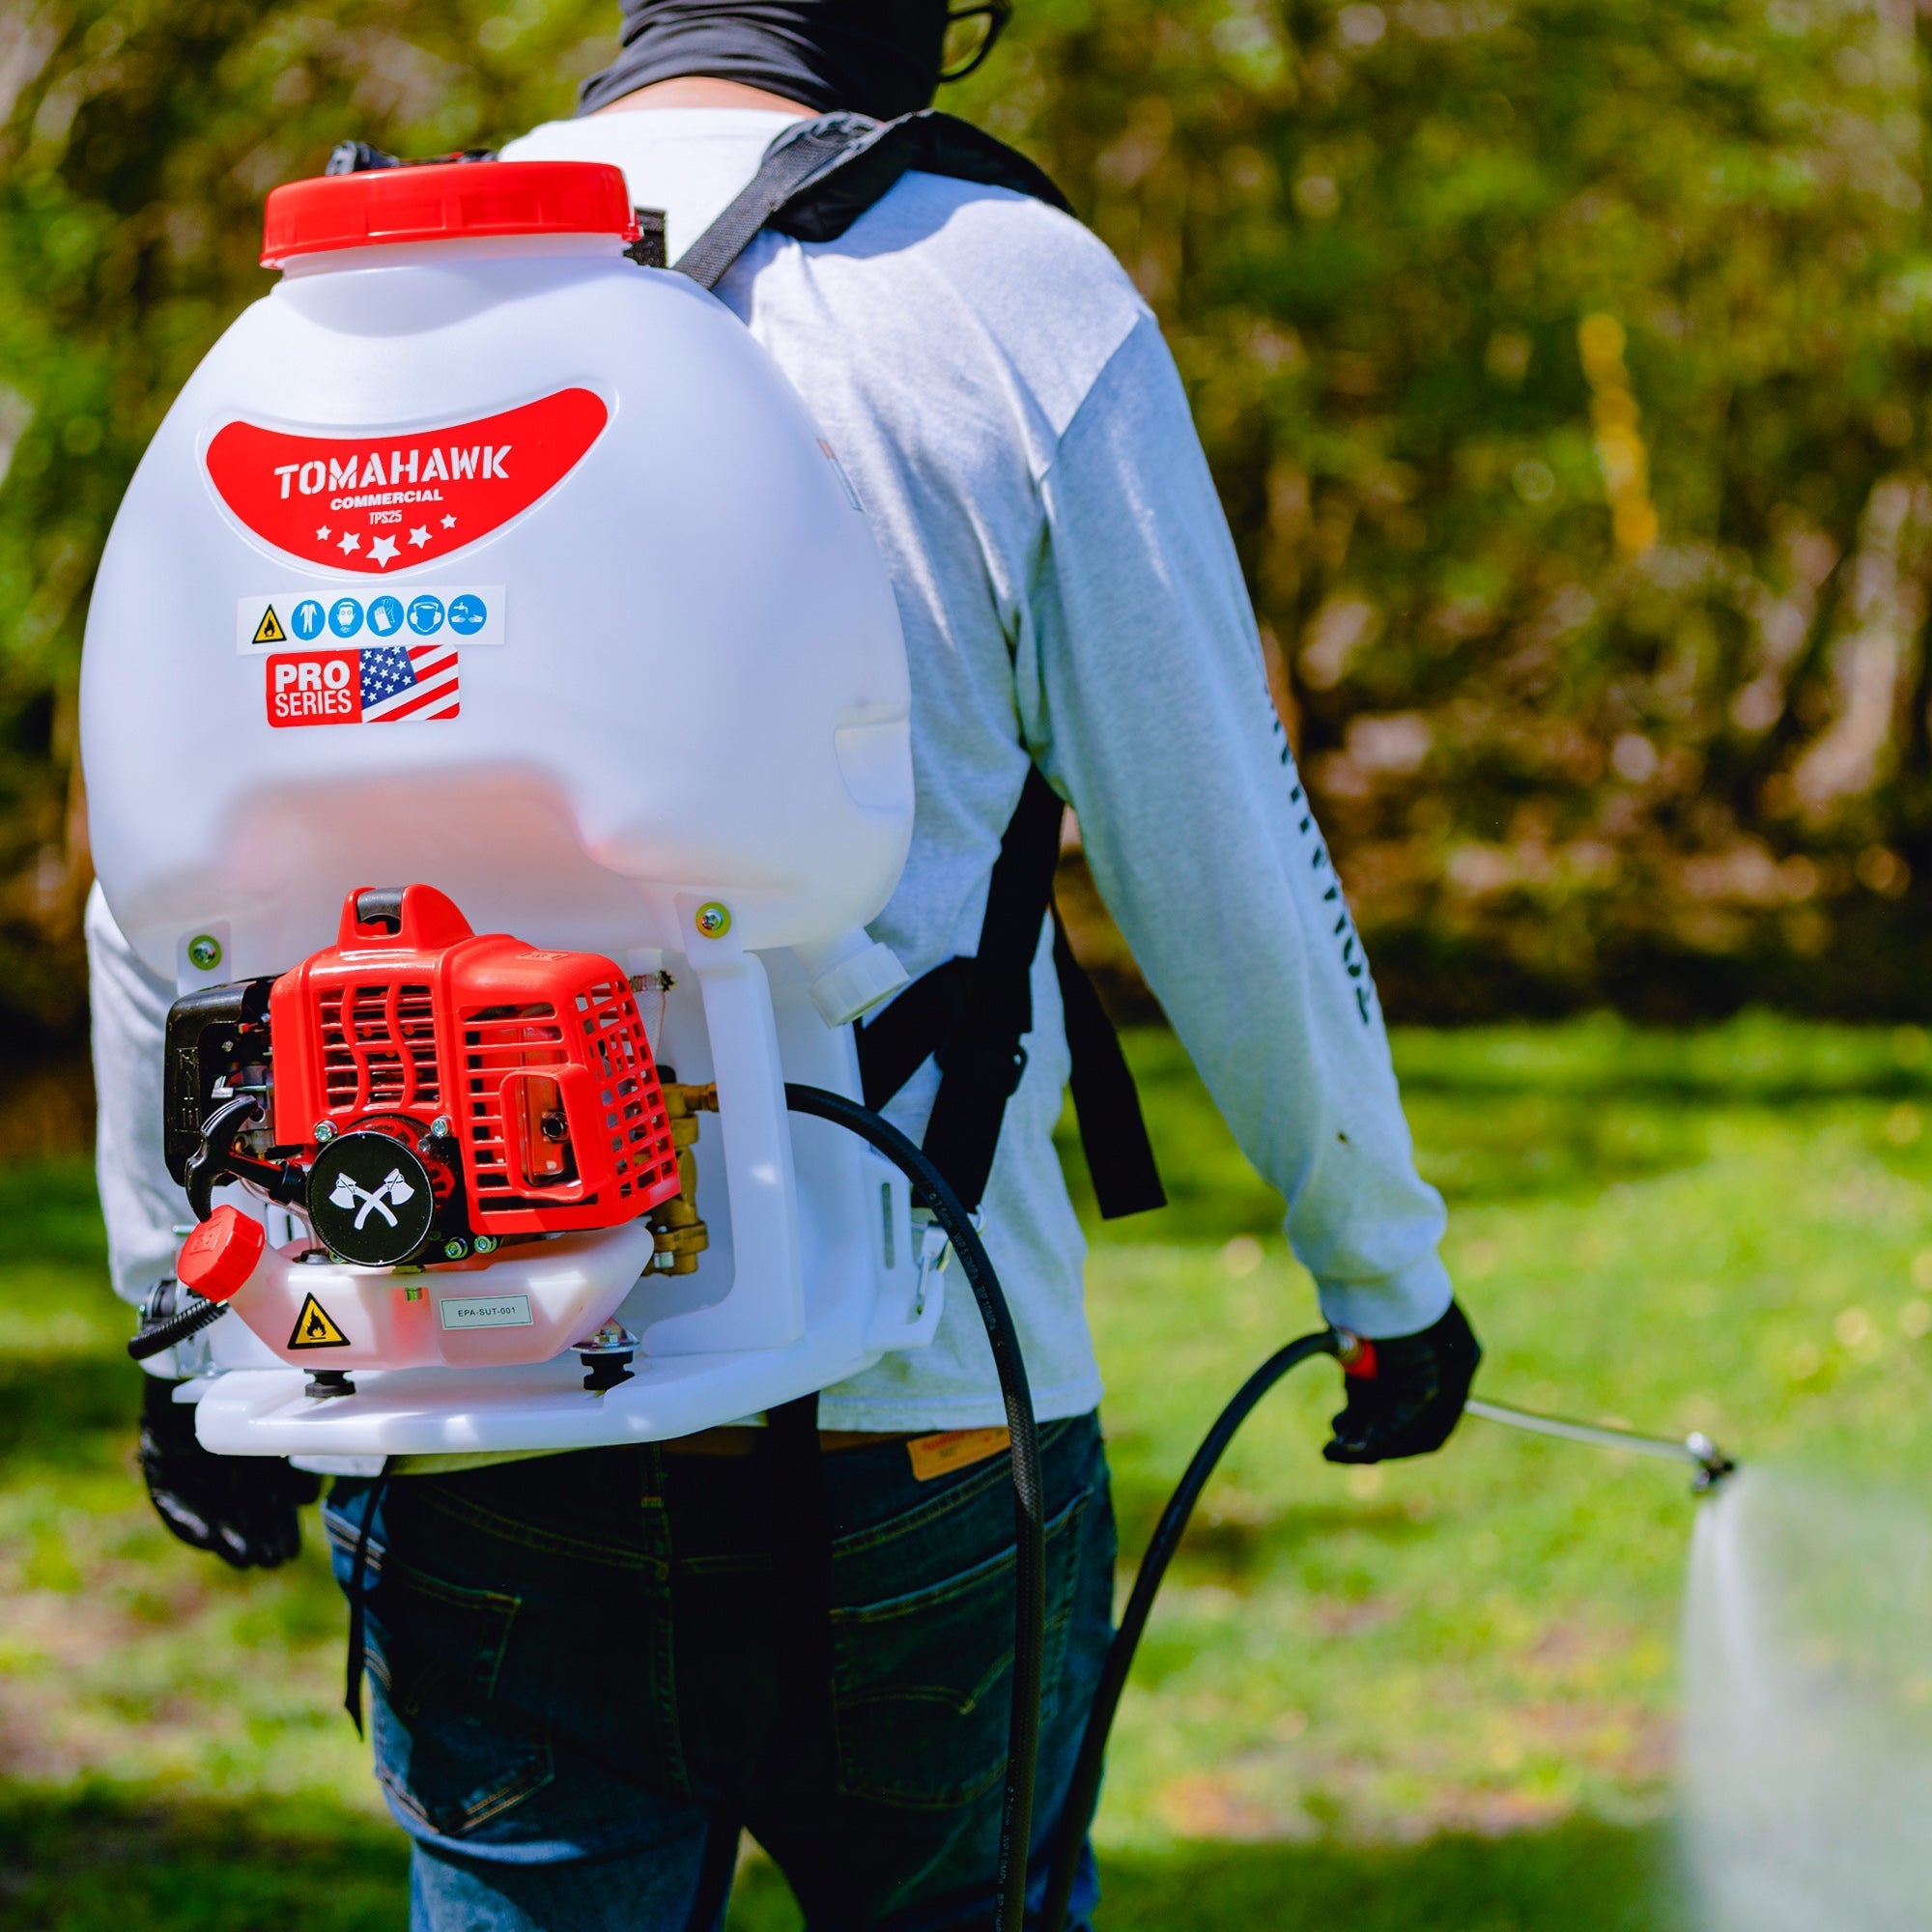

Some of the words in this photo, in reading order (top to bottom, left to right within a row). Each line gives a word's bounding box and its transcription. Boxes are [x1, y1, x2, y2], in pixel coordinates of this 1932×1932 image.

[273, 445, 513, 499] TOMAHAWK
[329, 489, 444, 511] COMMERCIAL
[368, 509, 403, 526] TPS25
[274, 660, 351, 693] PRO
[274, 689, 353, 718] SERIES
[457, 1306, 516, 1318] EPA-SUT-001
